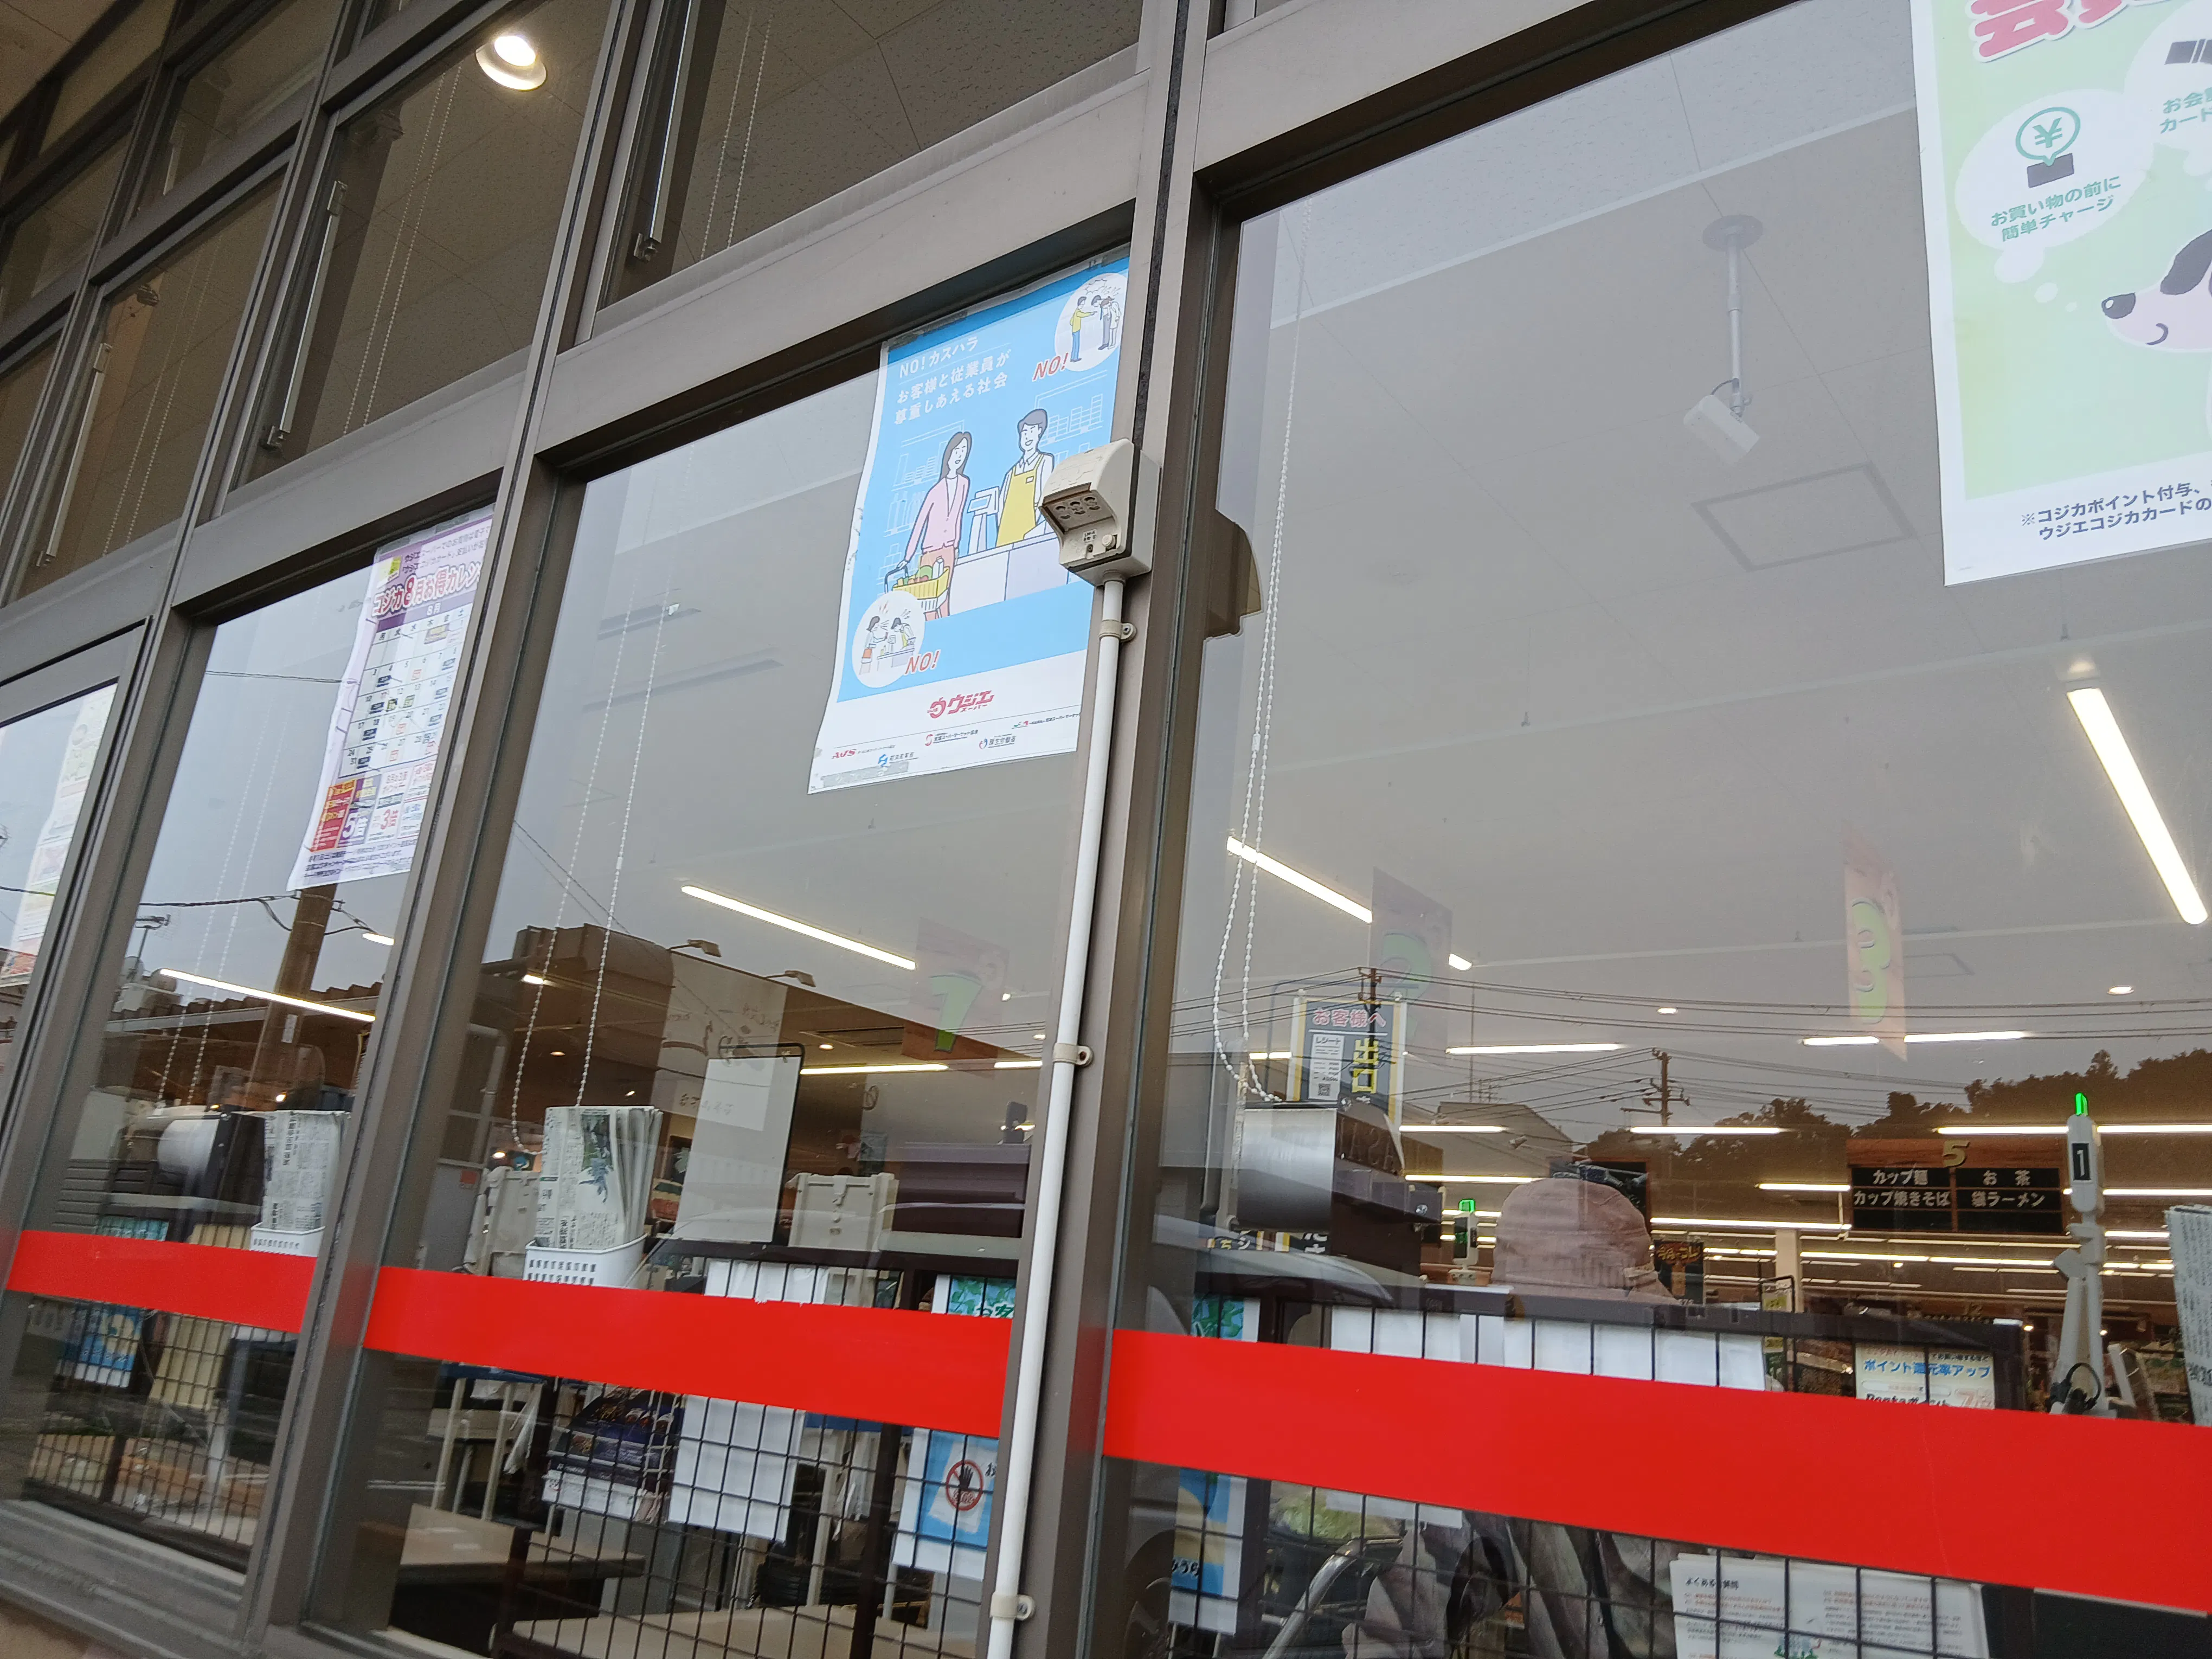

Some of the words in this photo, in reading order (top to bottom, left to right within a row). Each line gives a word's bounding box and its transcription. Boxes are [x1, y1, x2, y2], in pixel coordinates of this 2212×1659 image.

[1991, 176, 2121, 227] お買い物の前に
[2002, 194, 2114, 242] 簡単チャージ
[897, 349, 1012, 404] お客様と従業員が
[1032, 352, 1069, 382] NO!
[895, 372, 1008, 425] 尊重しあえる社会
[2021, 479, 2212, 526] ※コジカポイント付与、
[2039, 498, 2211, 540] ウジエコジカカードの
[904, 650, 942, 677] NO!
[947, 690, 995, 715] ウジエ
[1313, 1008, 1387, 1028] お客様へ
[1352, 1037, 1380, 1094] 出口
[1942, 1139, 1971, 1167] 5
[2076, 1149, 2085, 1178] 1
[1853, 1190, 1952, 1207] カップ焼きそば
